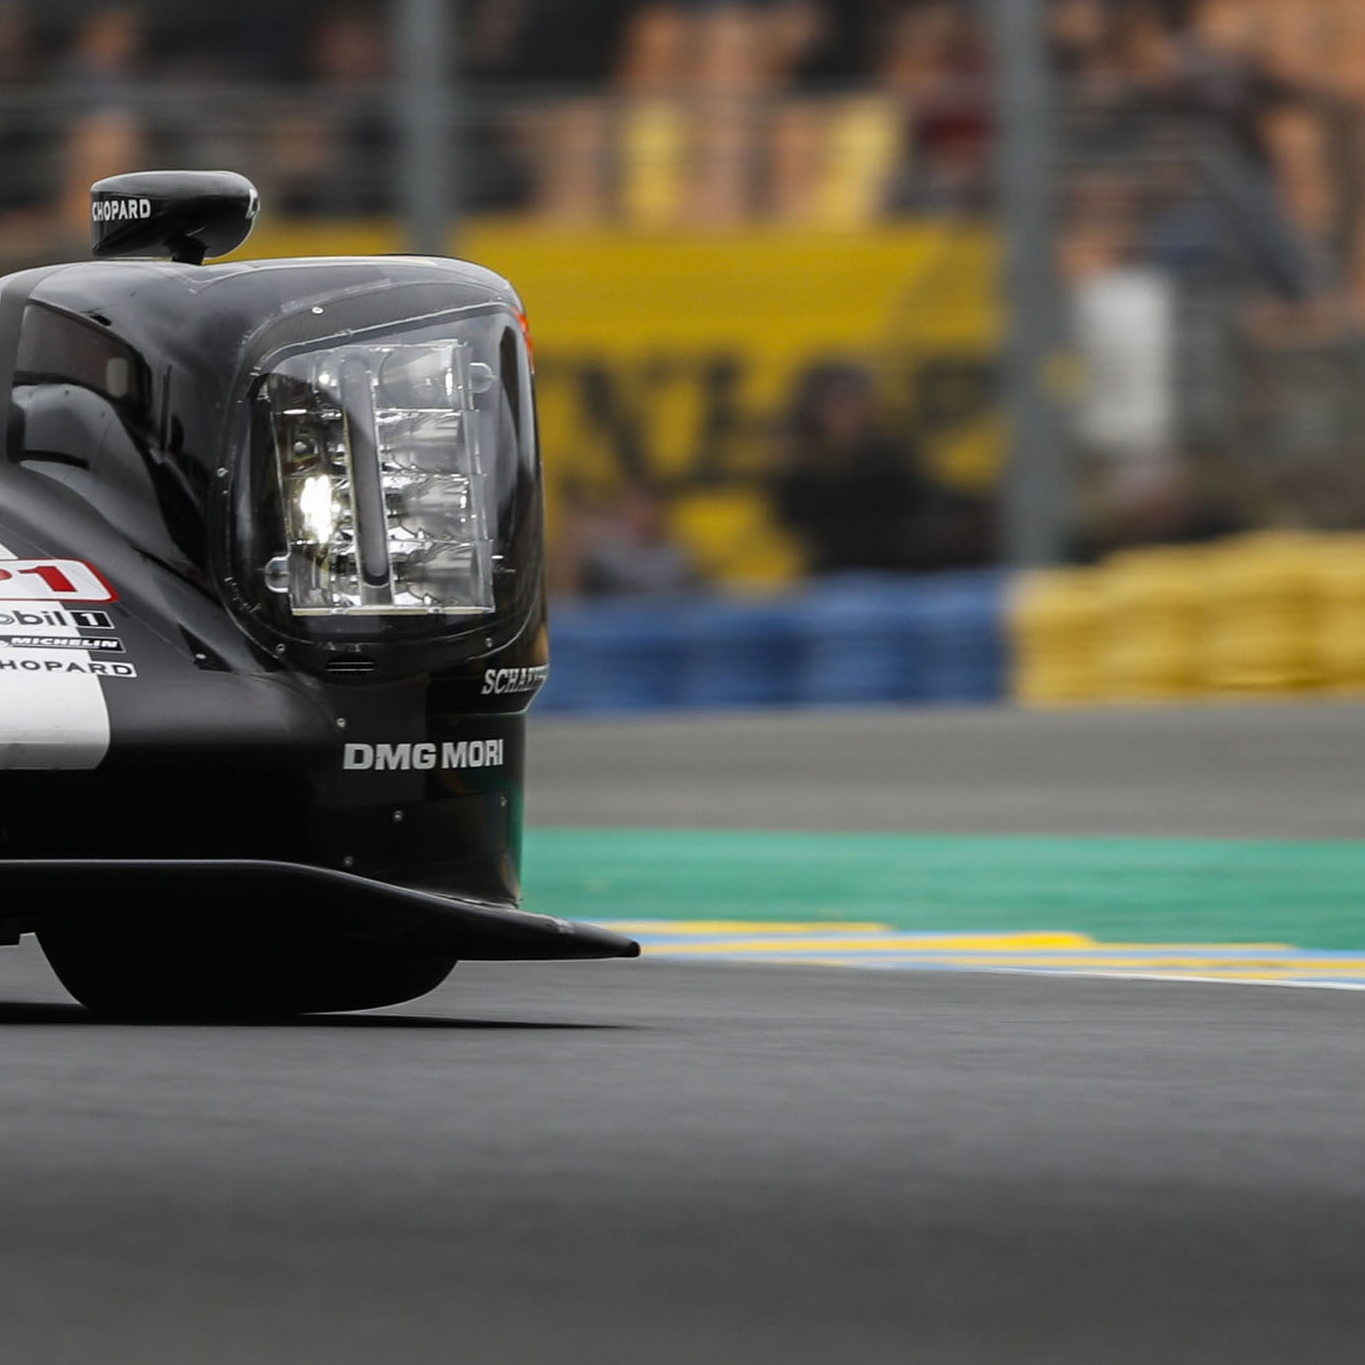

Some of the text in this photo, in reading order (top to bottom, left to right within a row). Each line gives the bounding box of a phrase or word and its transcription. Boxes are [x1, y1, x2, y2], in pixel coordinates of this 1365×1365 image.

[92, 199, 151, 221] CHOPARD
[10, 637, 119, 649] MICHELIN
[343, 739, 504, 770] DMG MORI
